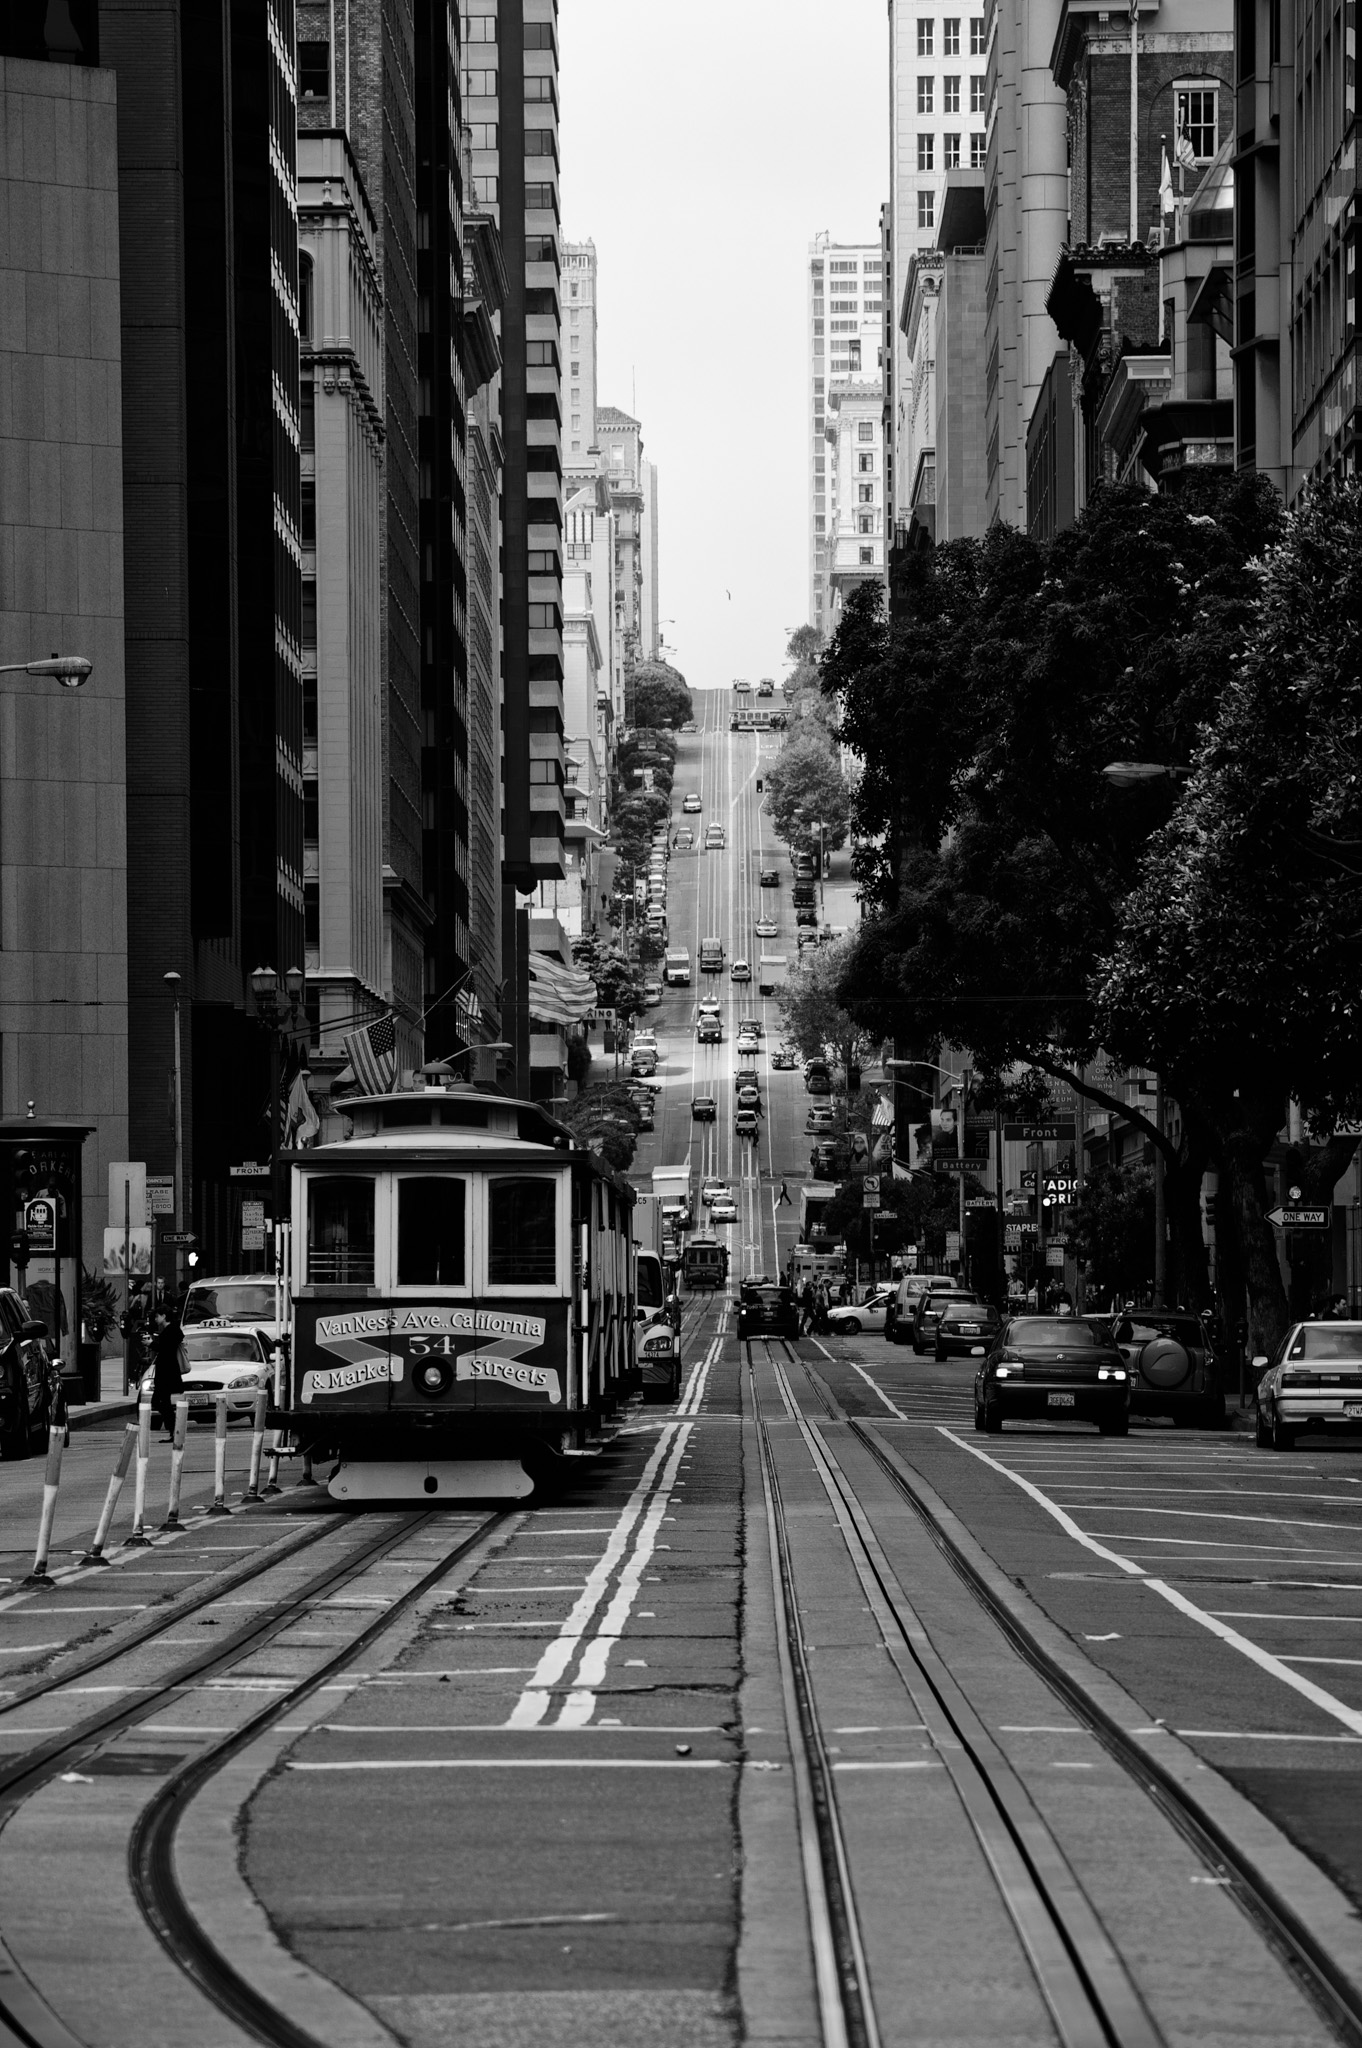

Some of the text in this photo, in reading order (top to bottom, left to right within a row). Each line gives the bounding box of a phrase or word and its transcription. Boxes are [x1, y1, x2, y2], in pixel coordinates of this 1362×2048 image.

[1023, 1127, 1058, 1137] Front
[942, 1161, 981, 1170] Battery
[1283, 1212, 1321, 1222] ONE WAY
[319, 1320, 352, 1337] Van
[352, 1315, 398, 1333] Ness
[450, 1312, 542, 1337] California
[409, 1335, 456, 1355] 54
[312, 1359, 548, 1389] & Market Streets
